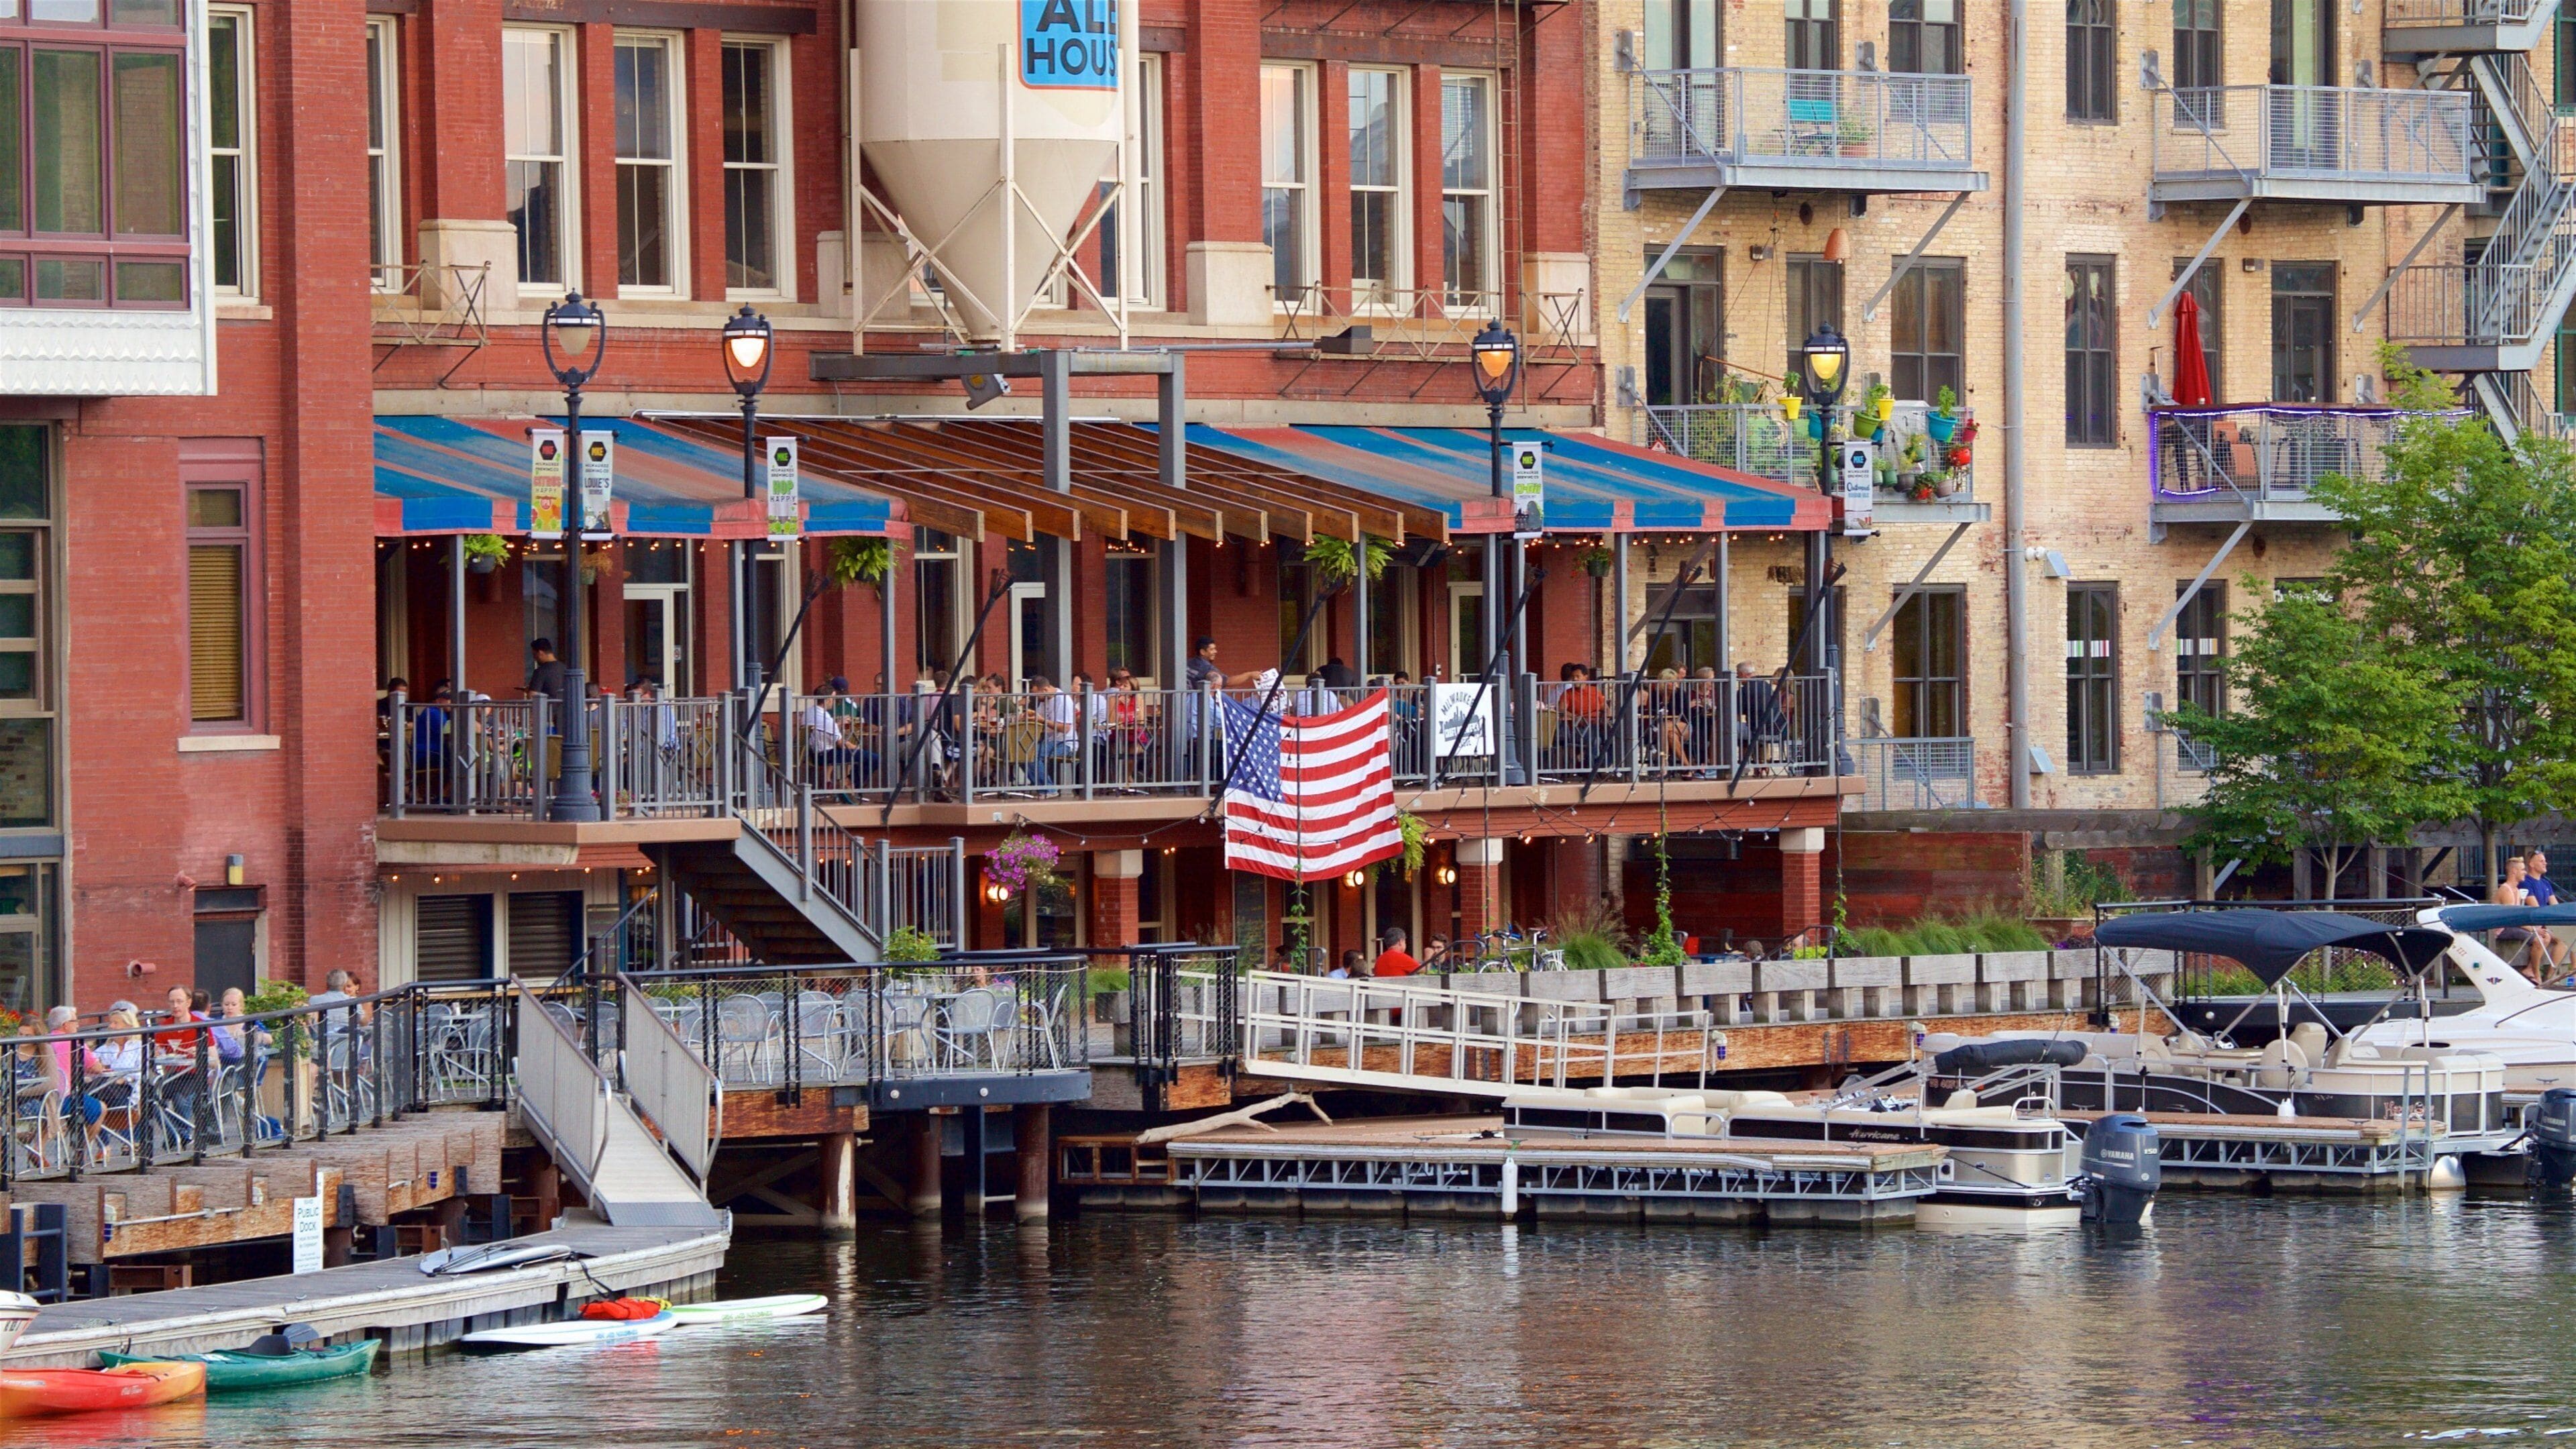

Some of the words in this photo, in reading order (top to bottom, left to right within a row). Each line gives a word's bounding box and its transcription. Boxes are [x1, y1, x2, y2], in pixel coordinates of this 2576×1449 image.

[1026, 38, 1117, 76] HOUS
[1522, 456, 1534, 464] MKE
[585, 478, 609, 488] LOUIE'S
[773, 480, 794, 494] HOP
[1849, 1128, 1900, 1140] Hurricane
[2107, 1150, 2135, 1161] YAMAHA
[298, 1207, 319, 1218] PUBLIC
[299, 1222, 317, 1232] DOCK
